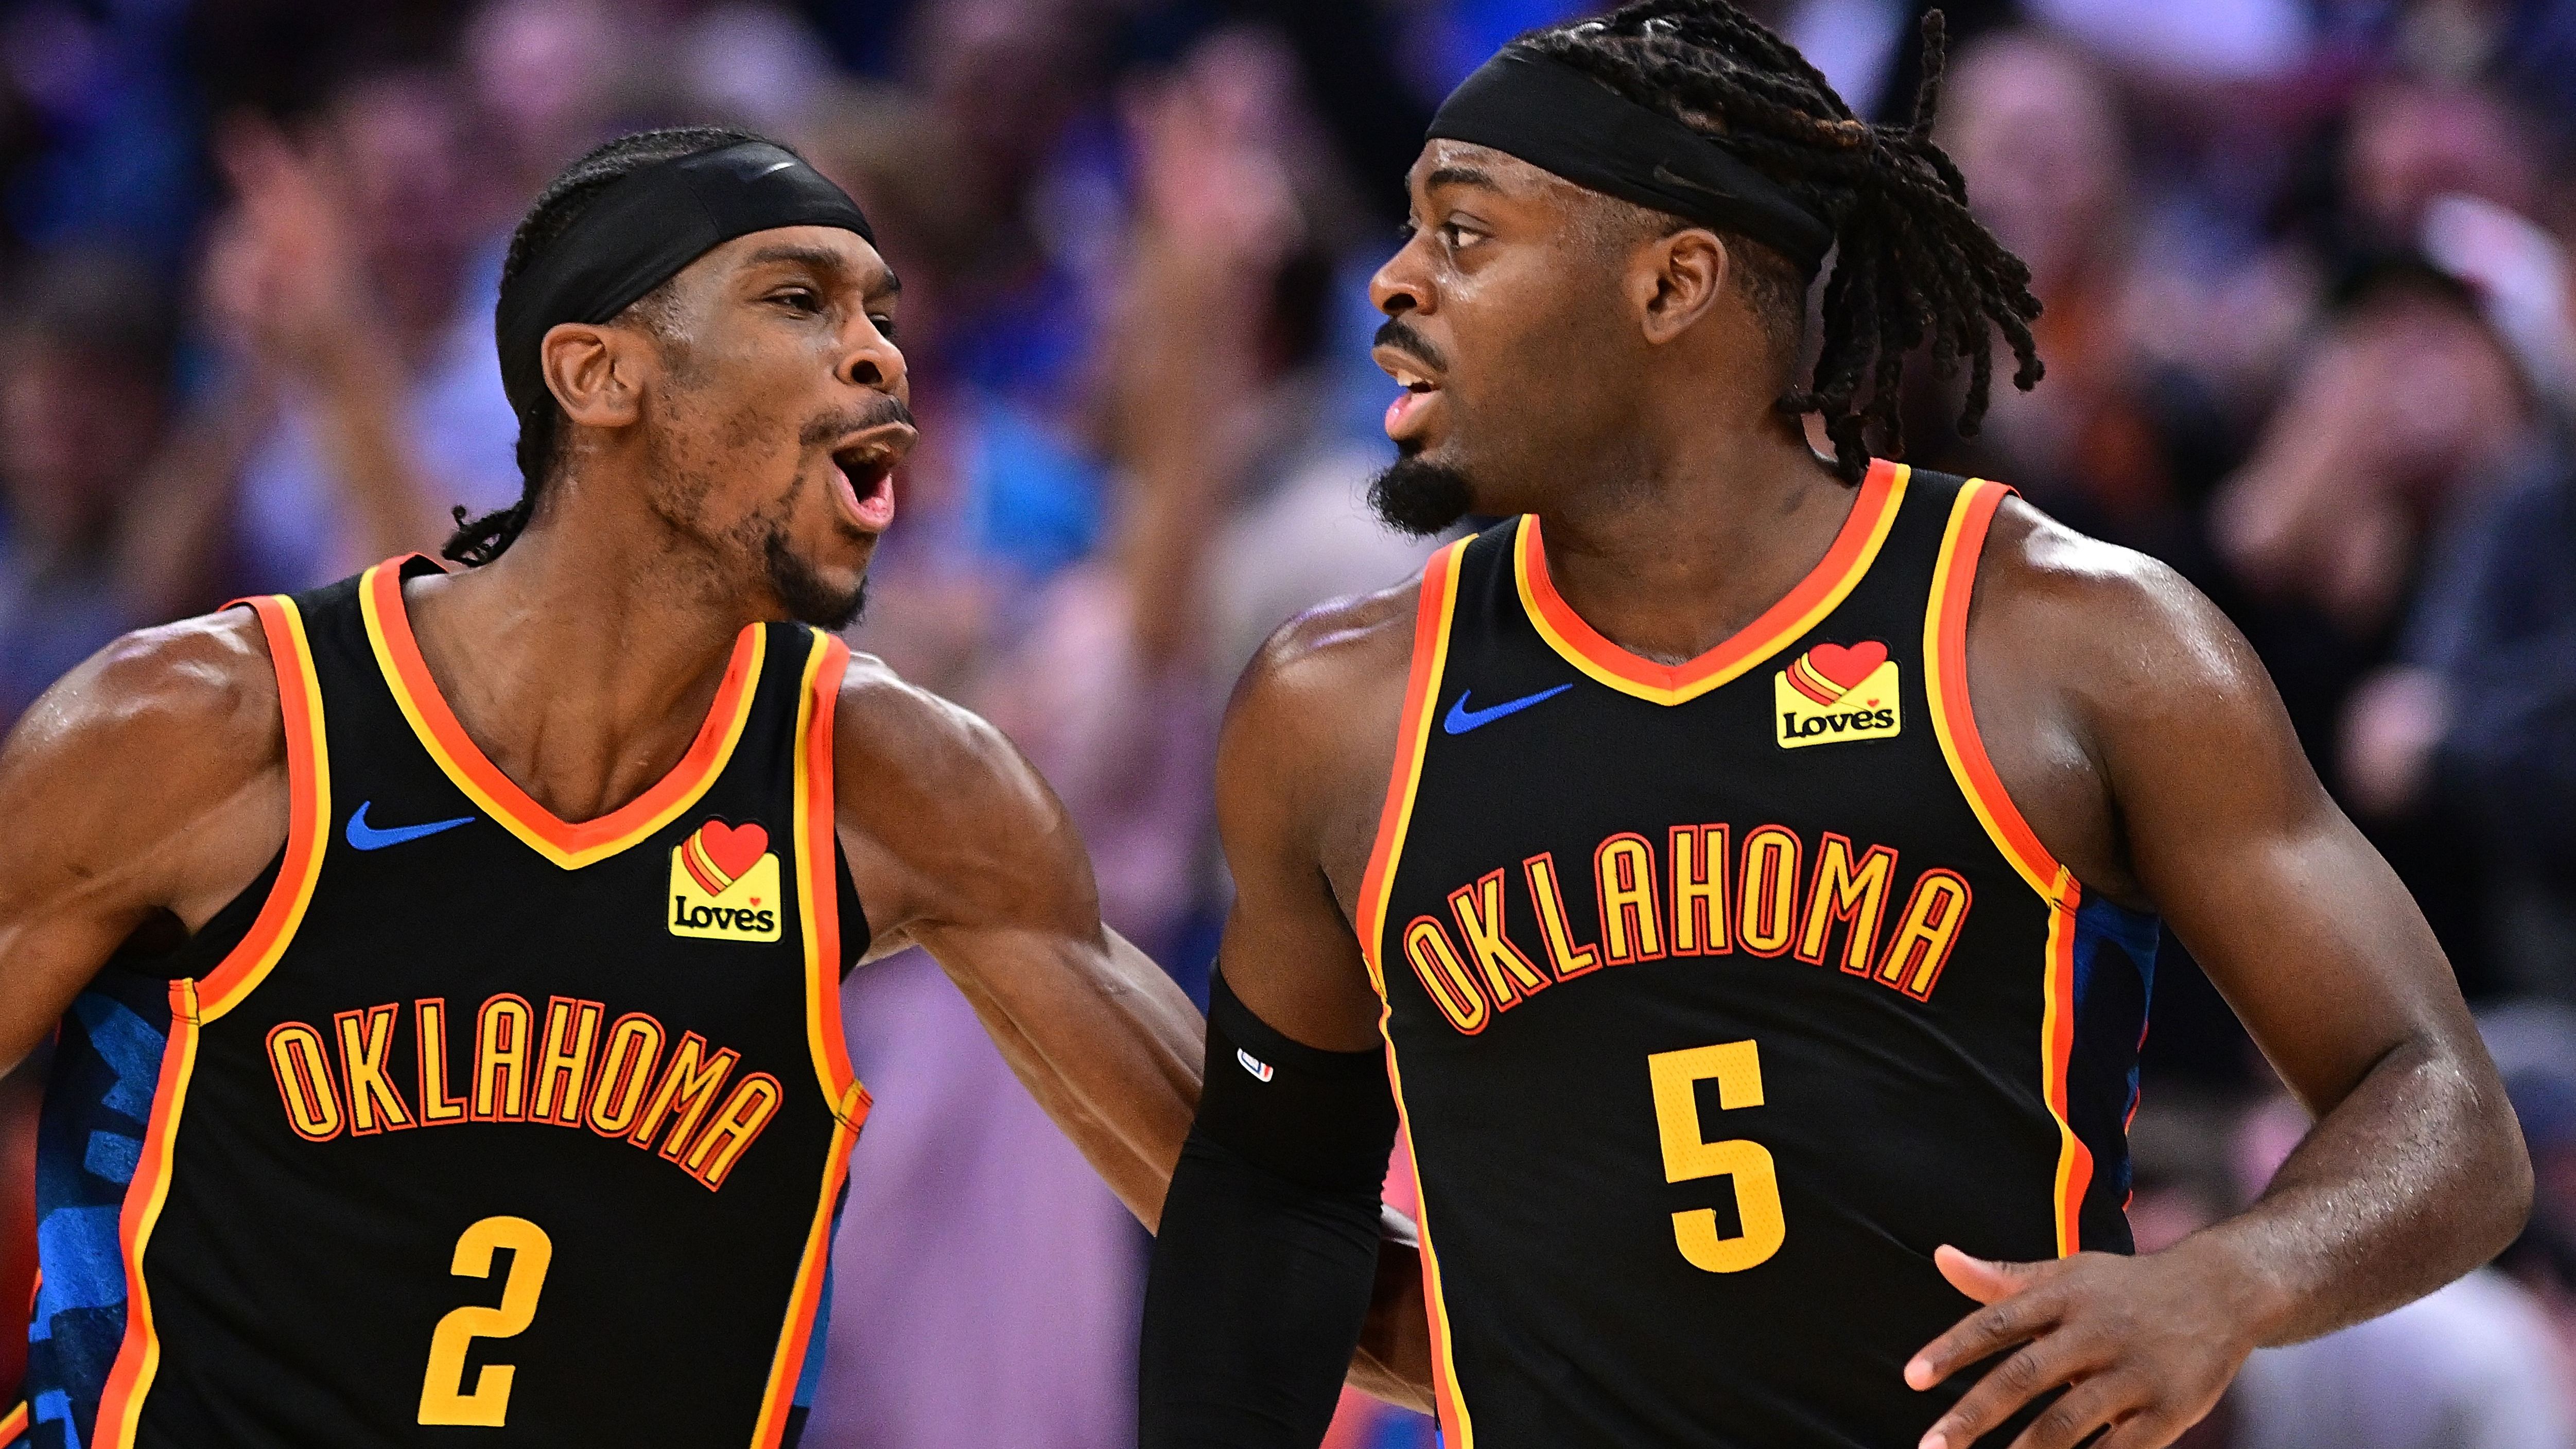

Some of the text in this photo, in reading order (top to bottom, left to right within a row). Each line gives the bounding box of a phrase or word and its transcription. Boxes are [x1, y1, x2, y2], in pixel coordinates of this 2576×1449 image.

[1403, 823, 1973, 1035] OKLAHOMA
[265, 993, 783, 1192] OKLAHOMA
[1648, 1039, 1786, 1273] 5
[417, 1215, 552, 1427] 2
